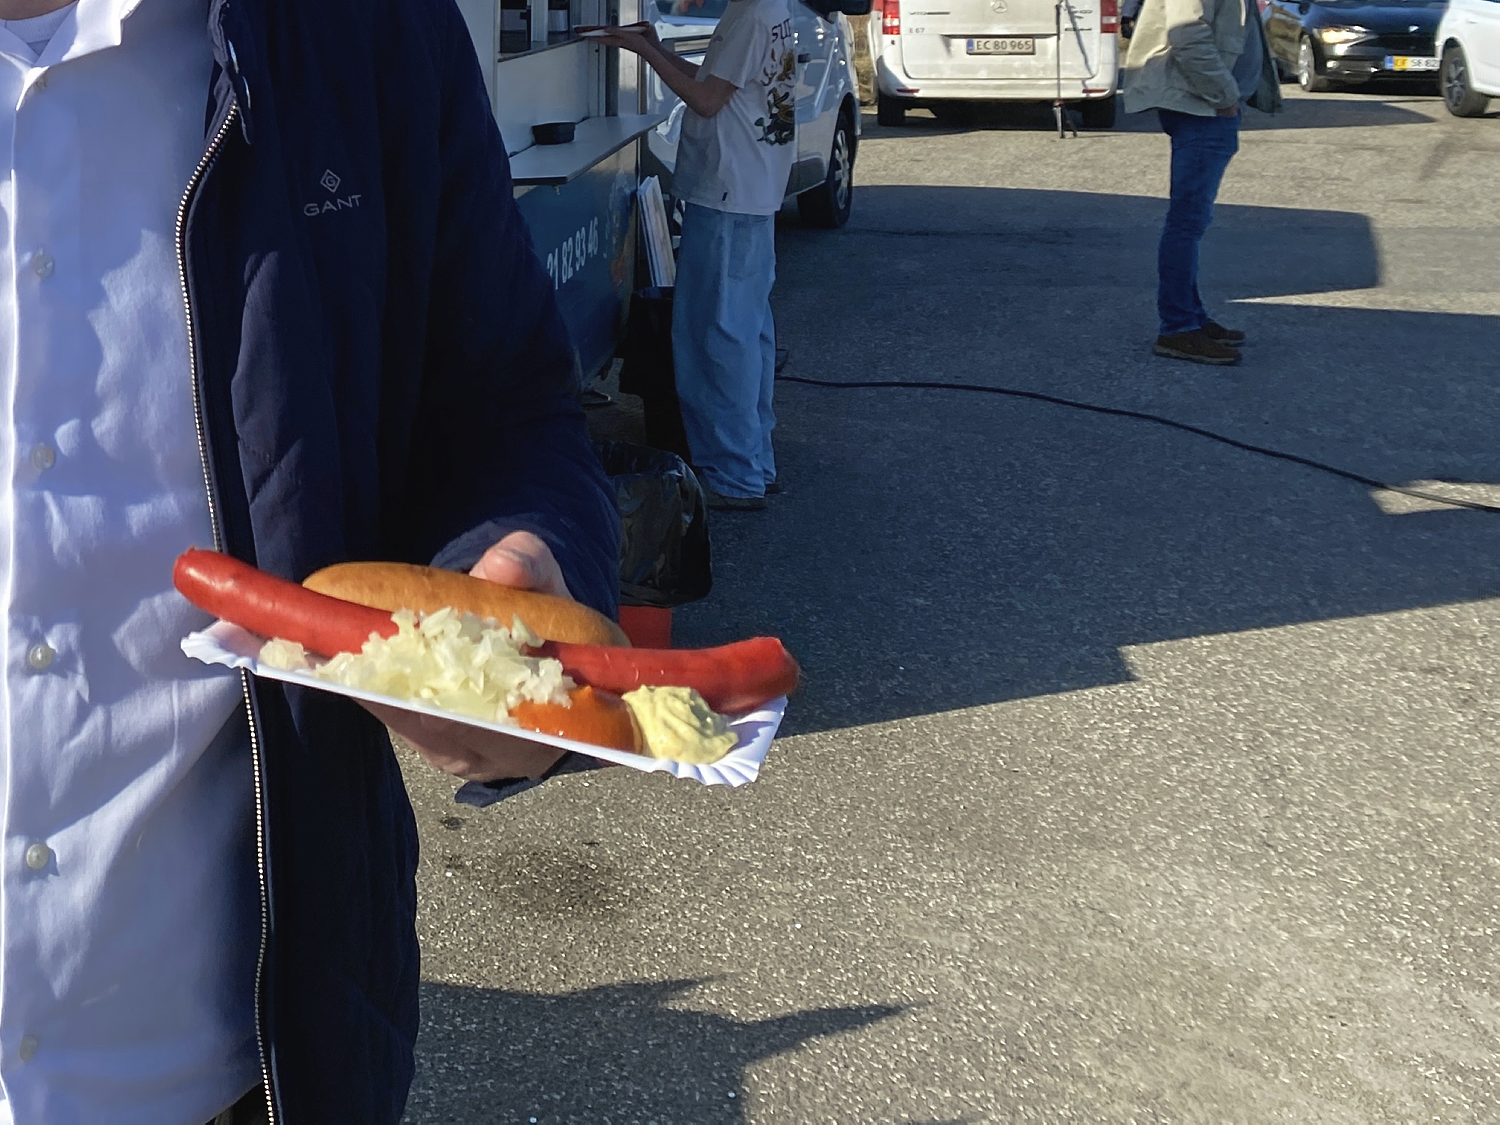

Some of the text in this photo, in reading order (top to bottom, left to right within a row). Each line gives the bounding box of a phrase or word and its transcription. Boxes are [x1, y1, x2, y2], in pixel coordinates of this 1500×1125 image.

[976, 40, 1032, 50] EC 80 965
[303, 194, 362, 216] GANT
[562, 237, 574, 283] 82
[575, 226, 586, 271] 93
[588, 216, 598, 258] 46
